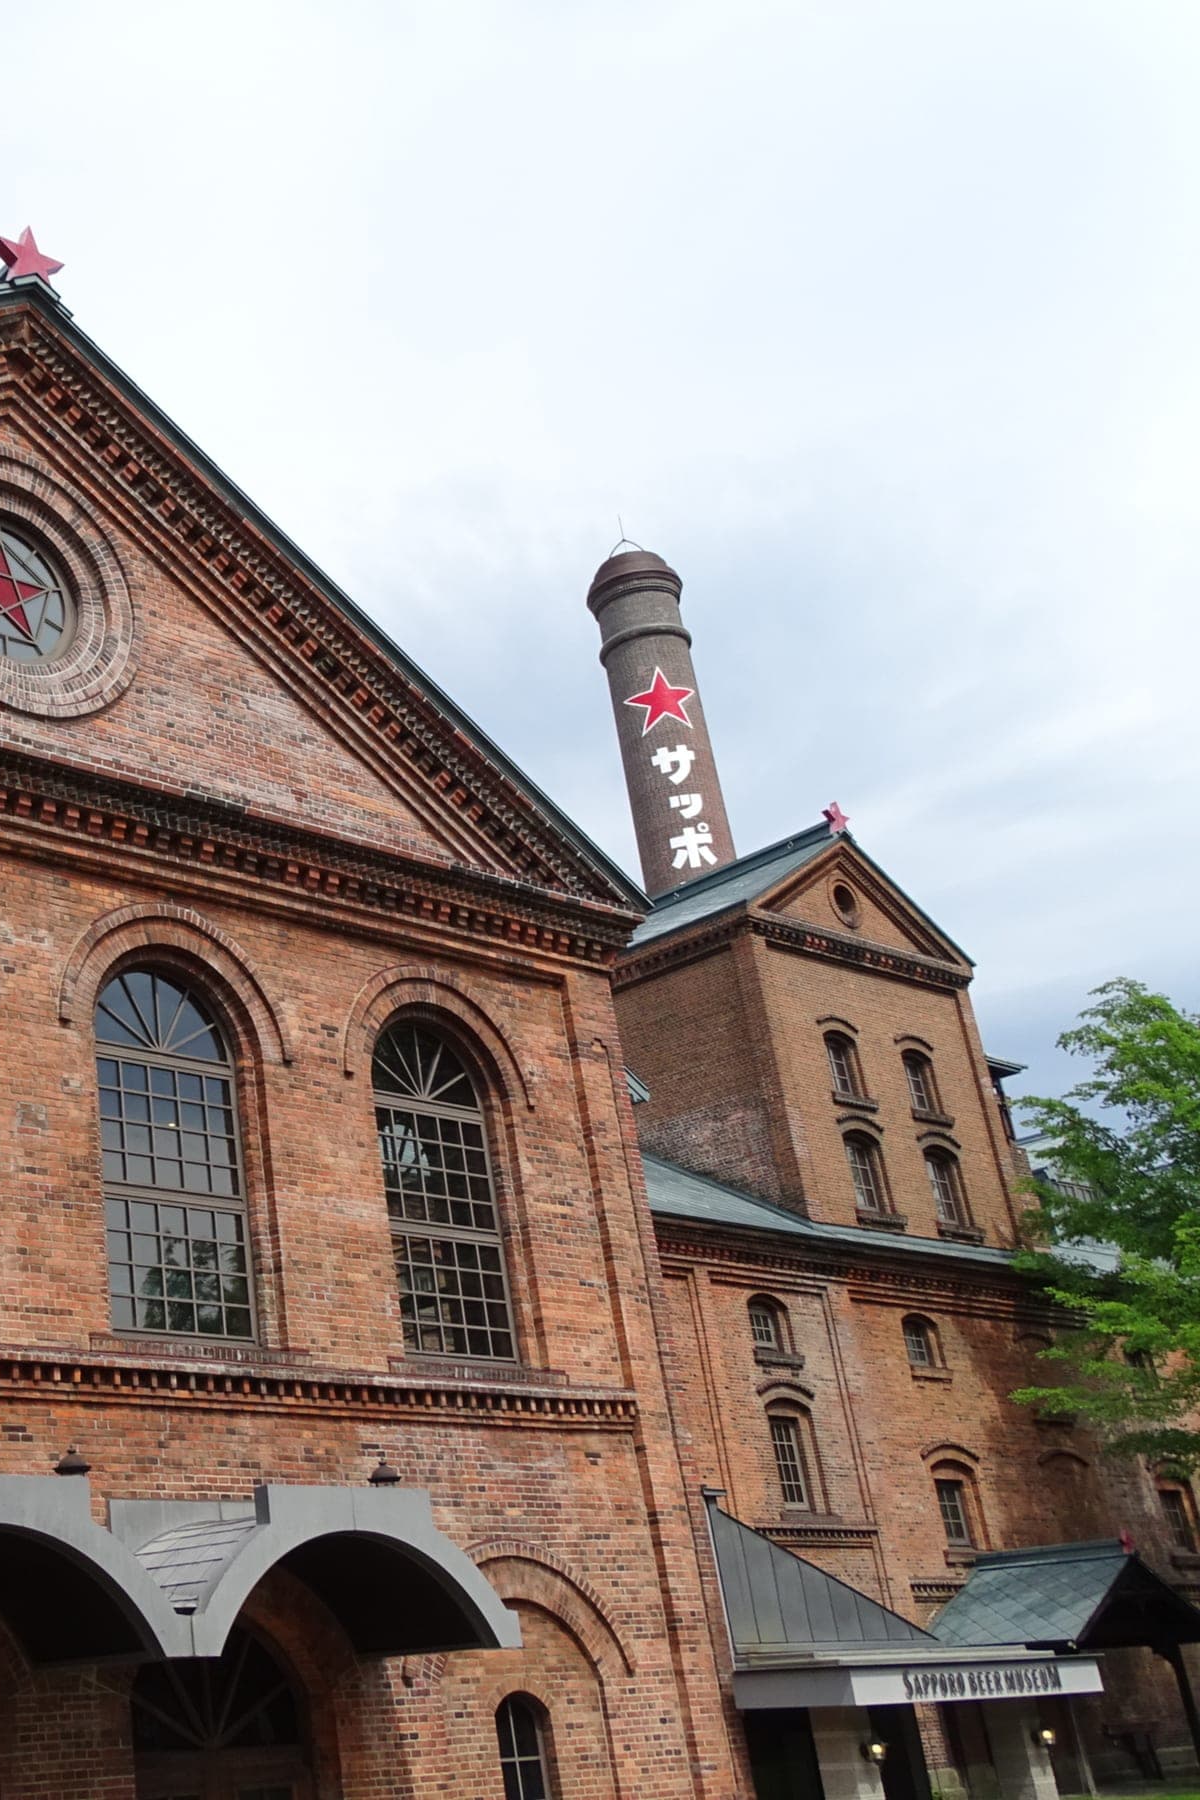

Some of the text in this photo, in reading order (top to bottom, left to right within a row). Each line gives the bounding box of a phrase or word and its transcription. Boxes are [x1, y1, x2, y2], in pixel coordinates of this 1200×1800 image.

[651, 744, 718, 885] サッポ
[903, 1664, 1062, 1699] SAPPORO BEER MUSEUM
